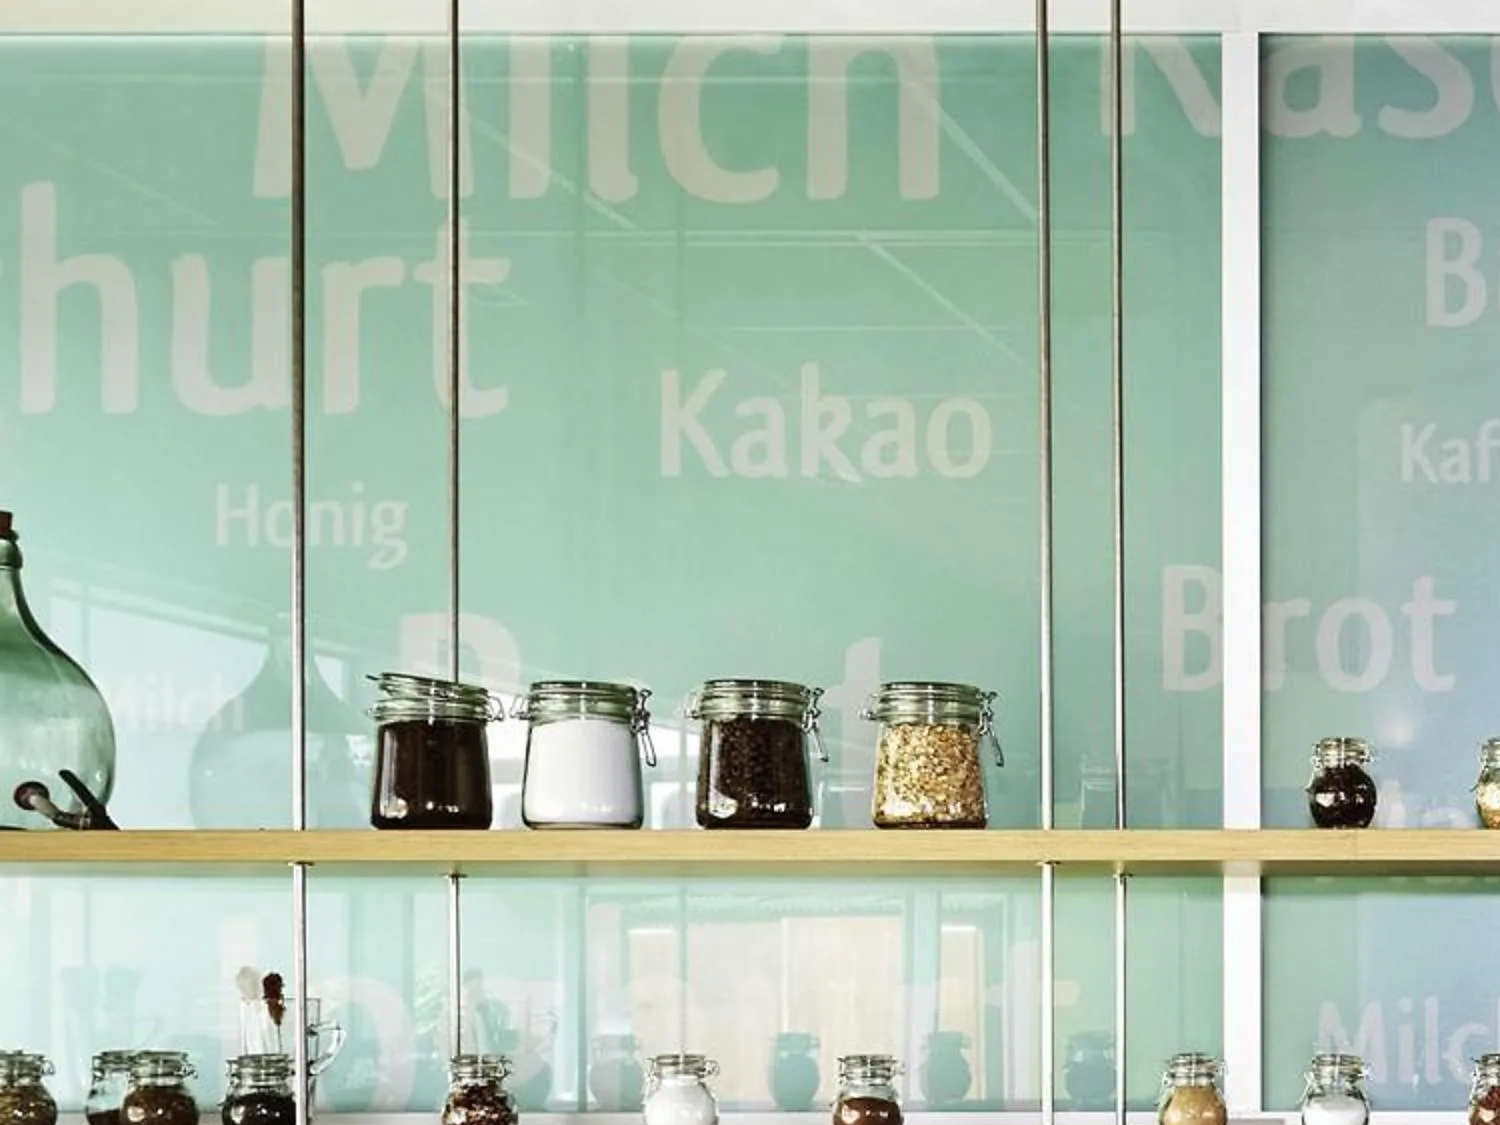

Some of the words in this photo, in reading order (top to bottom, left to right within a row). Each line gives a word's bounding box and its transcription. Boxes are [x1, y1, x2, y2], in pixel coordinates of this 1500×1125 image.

[659, 362, 994, 483] Kakao
[214, 480, 409, 568] Honig
[1160, 563, 1457, 695] Brot
